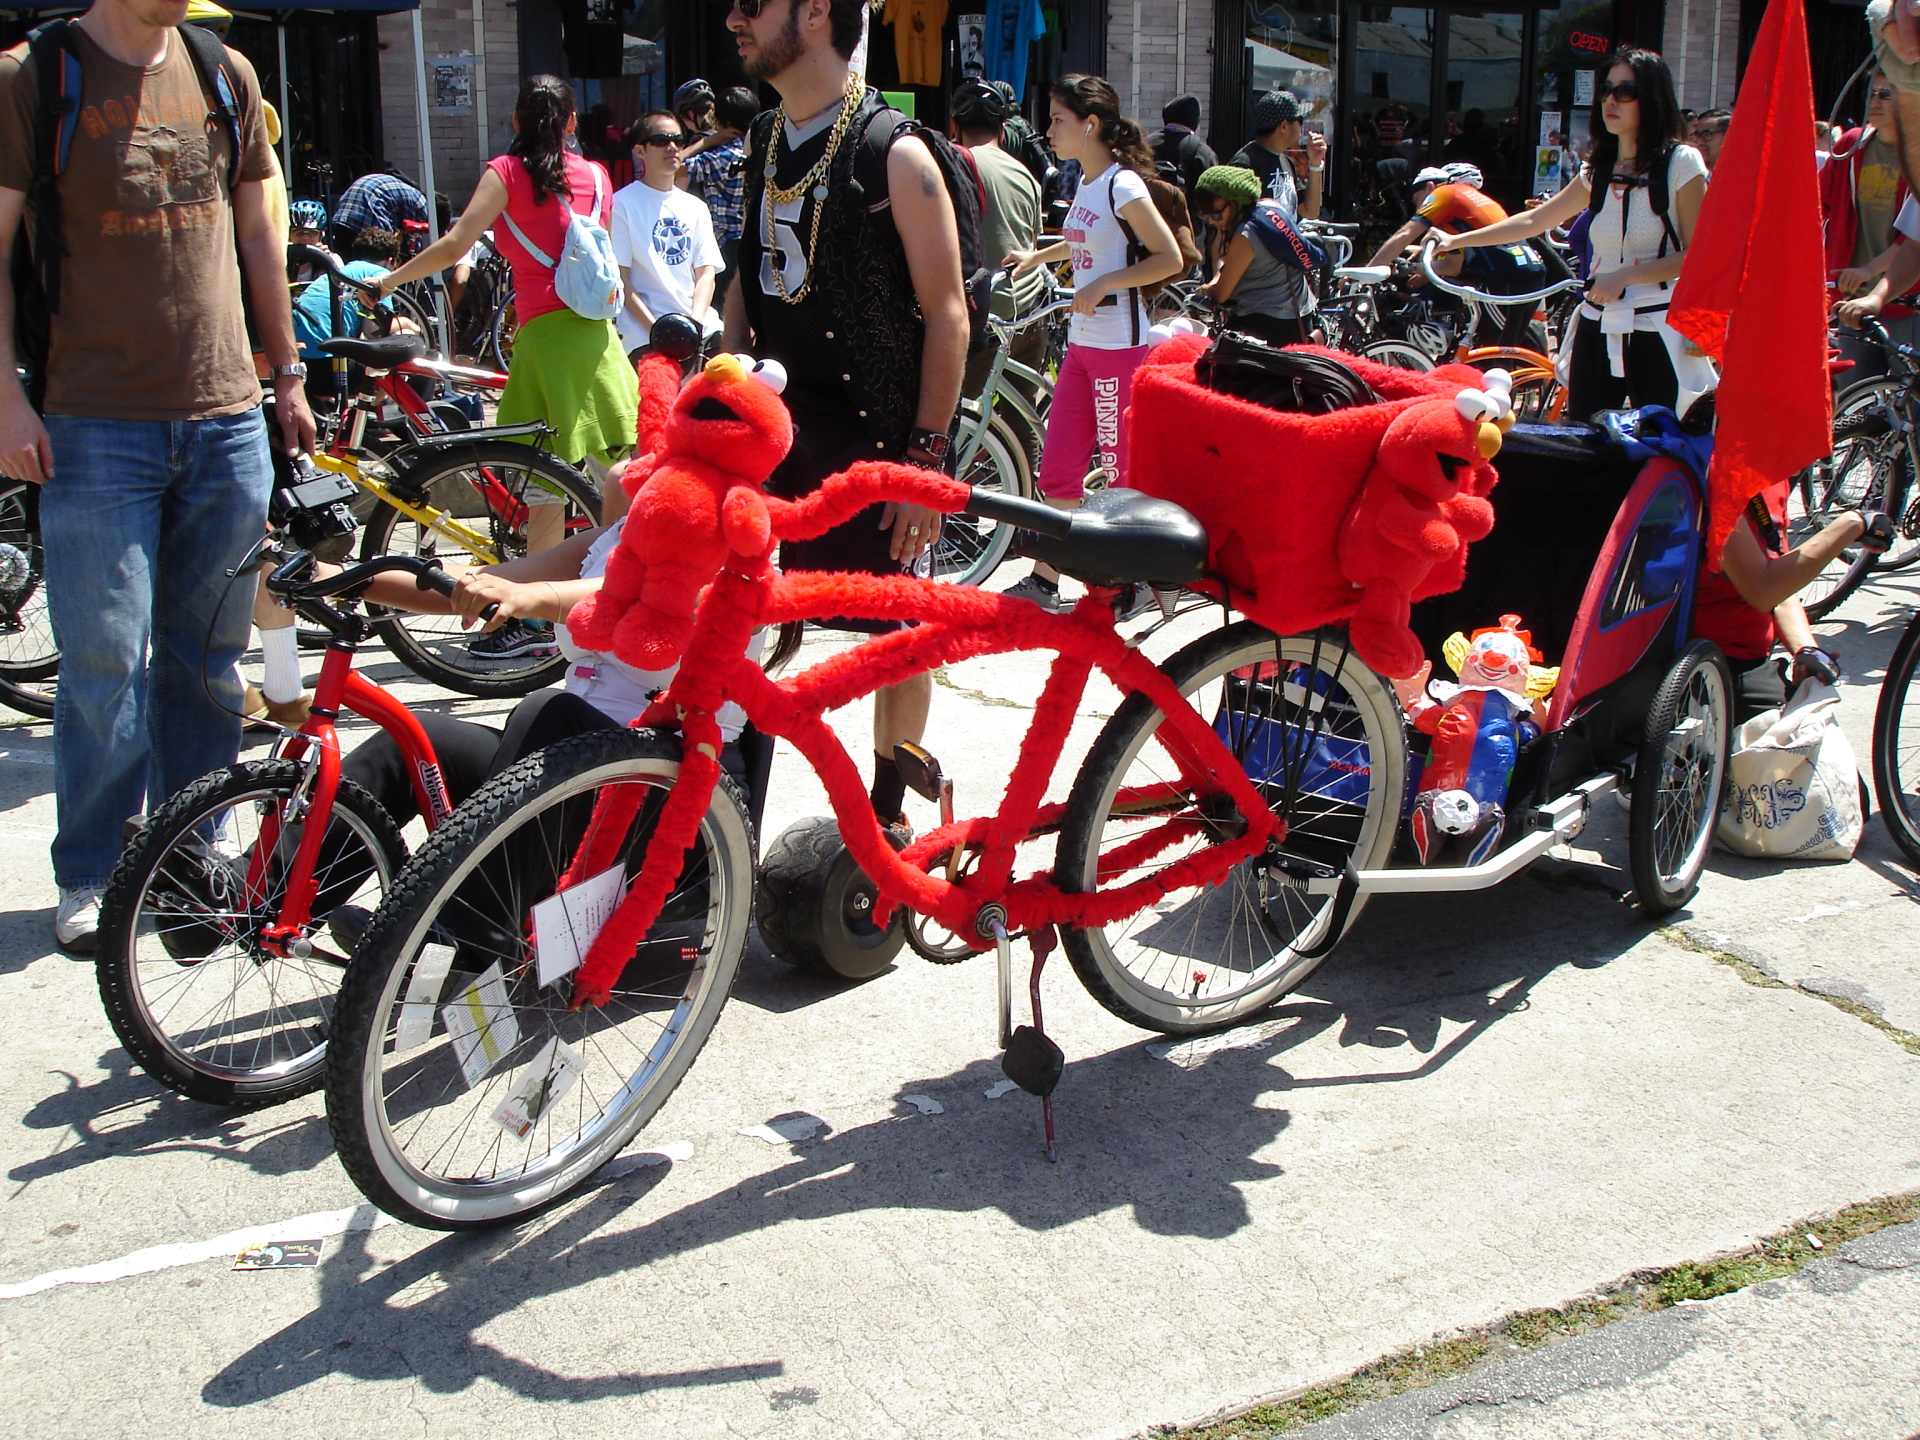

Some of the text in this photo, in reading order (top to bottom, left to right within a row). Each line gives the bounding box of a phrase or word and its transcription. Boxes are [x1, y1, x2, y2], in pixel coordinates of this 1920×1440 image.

[1569, 31, 1609, 53] OPEN
[1077, 206, 1100, 228] PINK
[759, 186, 807, 297] 5
[1095, 377, 1119, 447] PINK
[1862, 458, 1892, 511] ANITOU
[424, 765, 444, 792] HILL
[426, 780, 442, 810] KICKER
